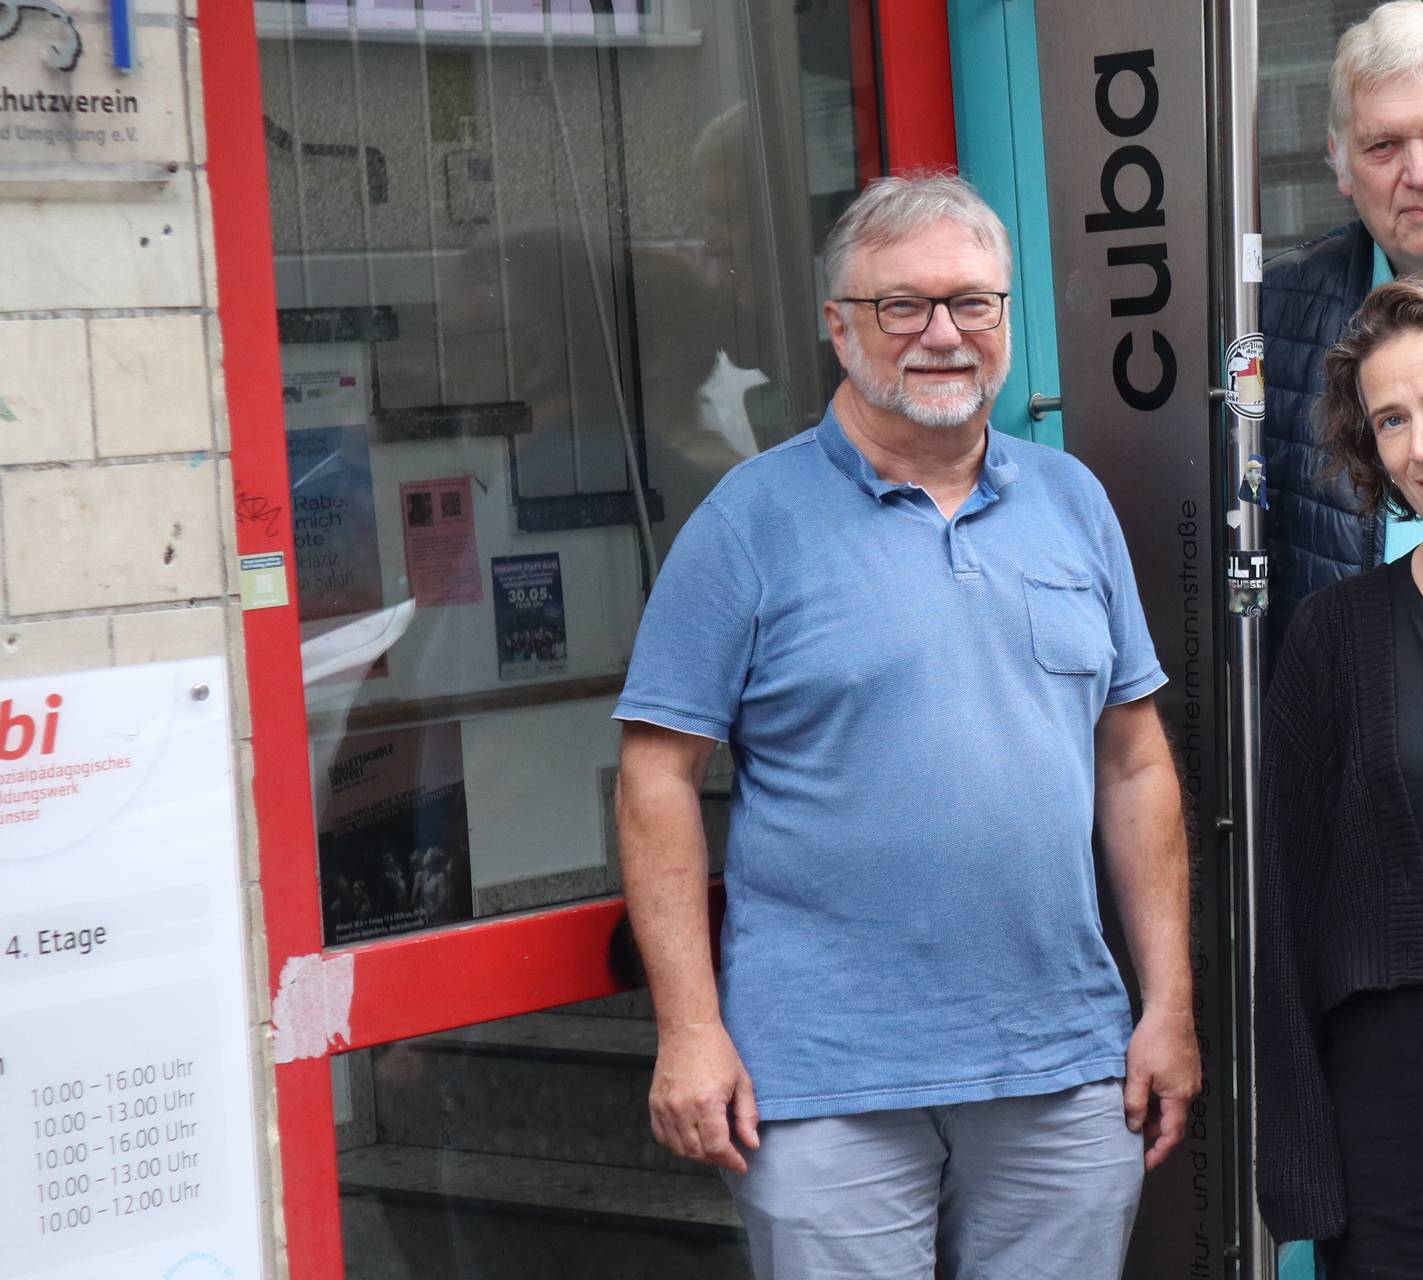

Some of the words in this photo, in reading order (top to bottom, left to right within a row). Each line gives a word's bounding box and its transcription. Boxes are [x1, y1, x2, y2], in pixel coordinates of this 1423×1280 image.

[0, 86, 139, 113] hutzverein
[1085, 48, 1178, 412] cuba
[508, 587, 553, 604] 30.05.
[5, 935, 29, 959] 4.
[38, 925, 108, 955] Etage
[32, 1080, 85, 1109] 10.00
[105, 1064, 156, 1094] 16.00
[162, 1058, 195, 1081] Uhr
[33, 1111, 86, 1140] 10.00
[107, 1095, 158, 1125] 13.00
[164, 1089, 196, 1113] Uhr
[34, 1142, 88, 1172] 10.00
[108, 1126, 159, 1157] 16.00
[165, 1119, 198, 1144] Uhr
[36, 1173, 90, 1204] 10.00
[110, 1157, 161, 1188] 13.00
[167, 1150, 200, 1175] Uhr
[1187, 1150, 1210, 1211] und
[38, 1204, 92, 1235] 10.00
[112, 1187, 164, 1218] 12.00
[169, 1180, 202, 1206] Uhr
